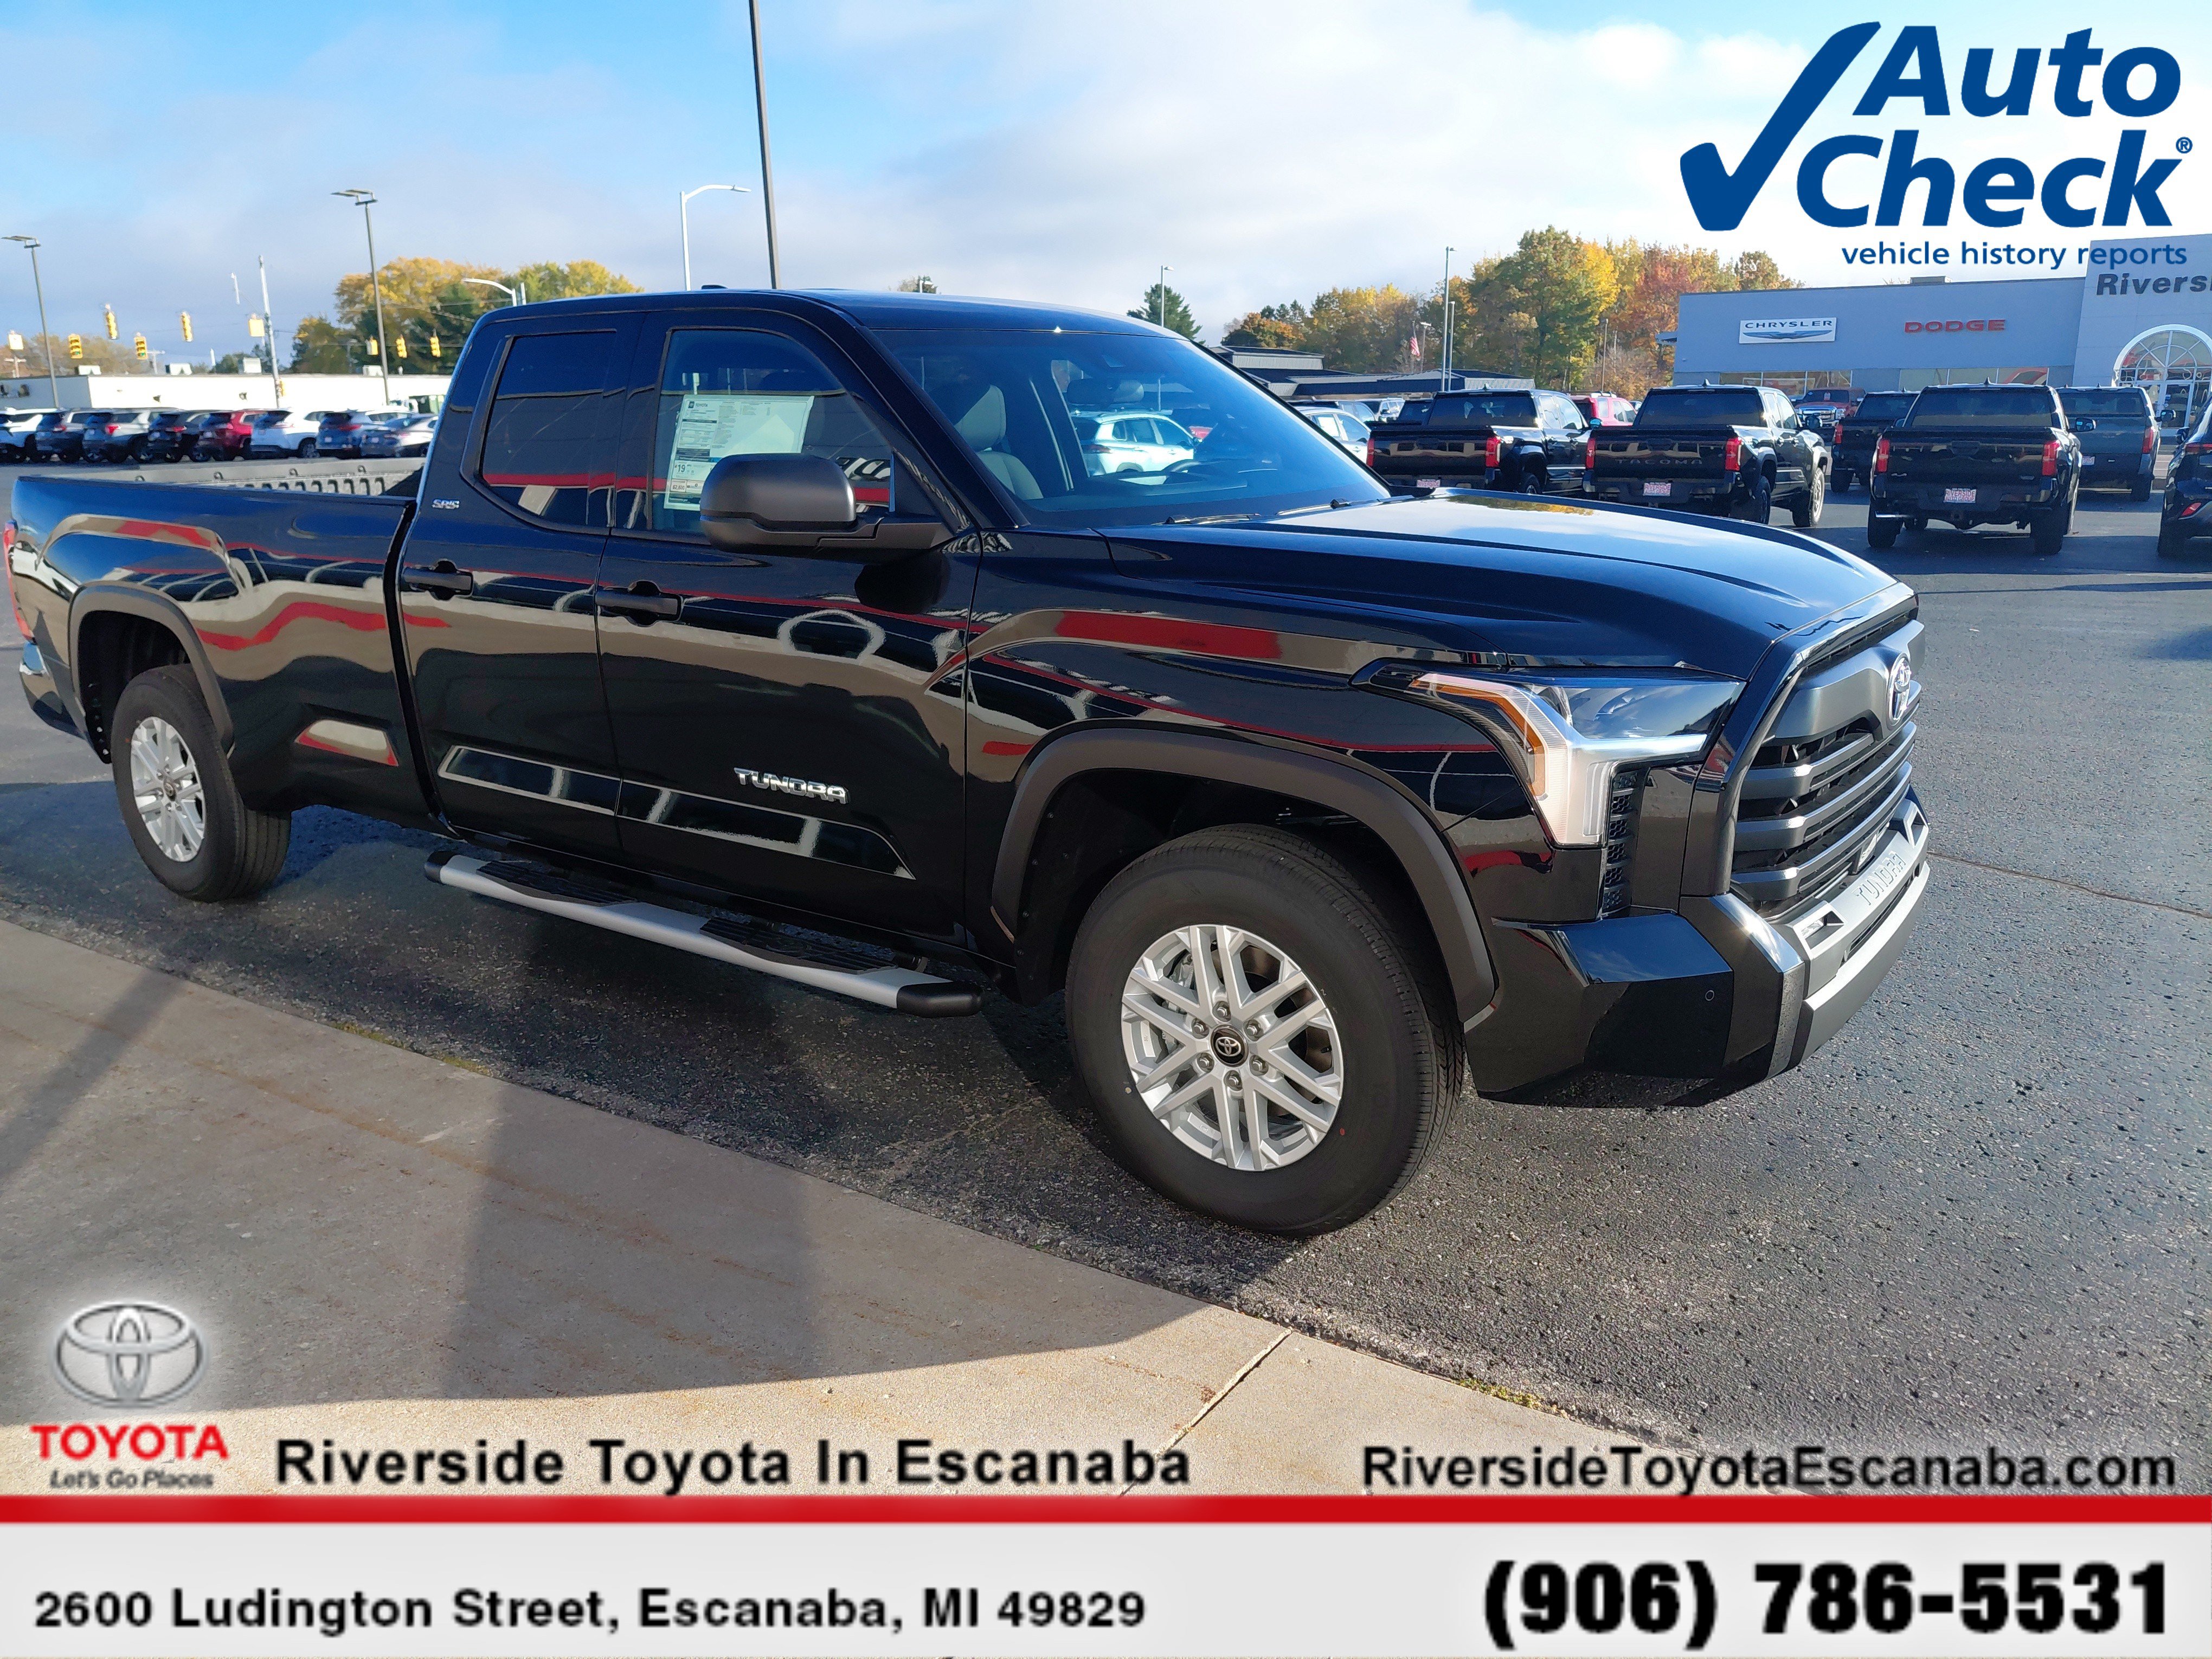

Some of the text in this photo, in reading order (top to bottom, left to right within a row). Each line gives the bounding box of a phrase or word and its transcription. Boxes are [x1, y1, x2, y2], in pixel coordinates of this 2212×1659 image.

[1745, 320, 1833, 329] CHRYSLER
[1904, 319, 2006, 333] DODGE
[734, 767, 850, 805] TUNDRA
[1851, 850, 1906, 906] TUNDRA
